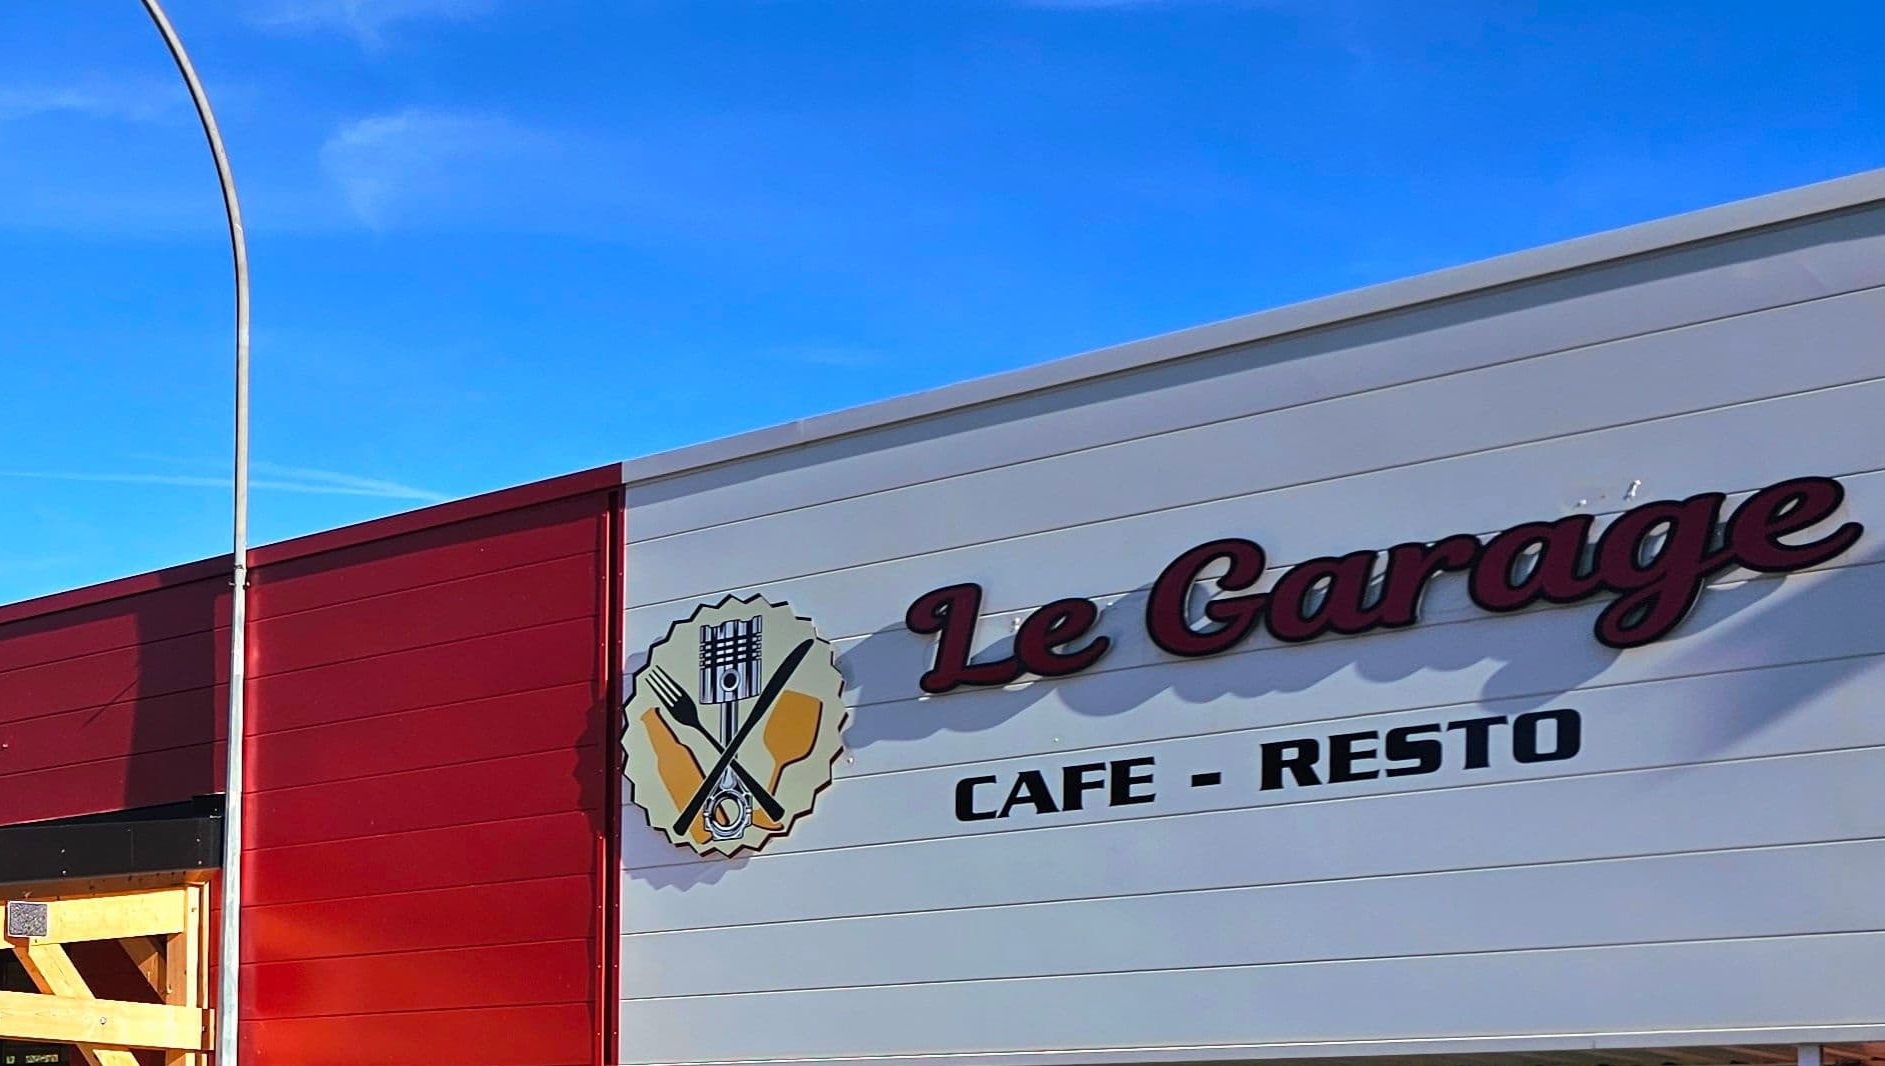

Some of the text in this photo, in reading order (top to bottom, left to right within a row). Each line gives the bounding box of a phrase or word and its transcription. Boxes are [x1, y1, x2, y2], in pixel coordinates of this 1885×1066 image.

[905, 475, 1865, 693] Le Garage
[955, 757, 1156, 821] CAFE
[1259, 708, 1582, 791] RESTO
